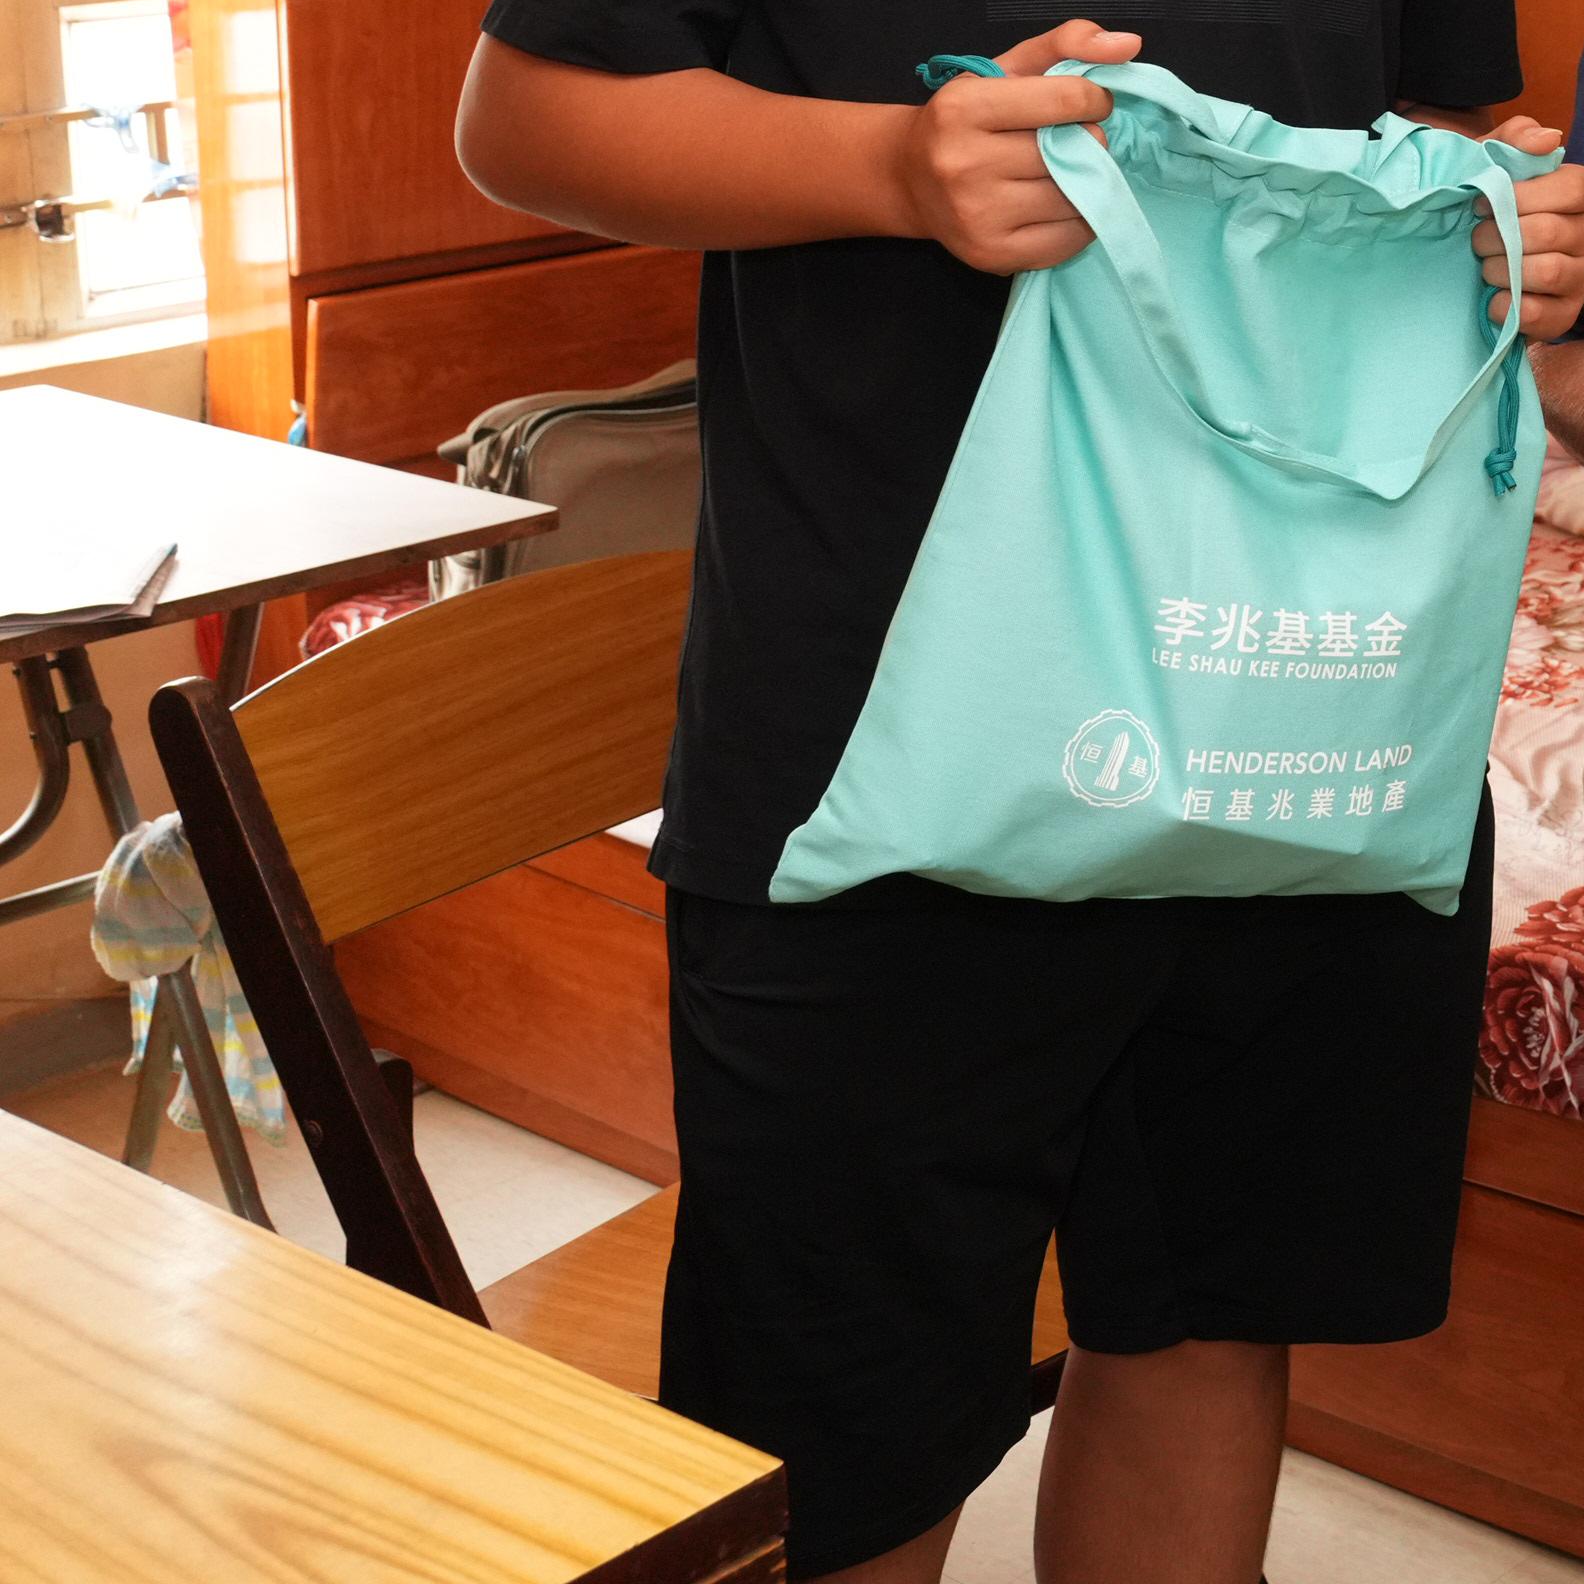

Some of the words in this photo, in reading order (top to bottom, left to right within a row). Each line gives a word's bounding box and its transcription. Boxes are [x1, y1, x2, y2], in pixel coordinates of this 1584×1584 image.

[1153, 596, 1408, 657] 李兆基基金
[1152, 647, 1182, 670] LEE
[1188, 654, 1243, 677] SHAU
[1247, 659, 1280, 678] KEE
[1285, 662, 1398, 680] FOUNDATION
[1186, 749, 1348, 776] HENDERSON
[1354, 744, 1413, 770] LAND
[1181, 779, 1408, 821] 恒基兆業地產
